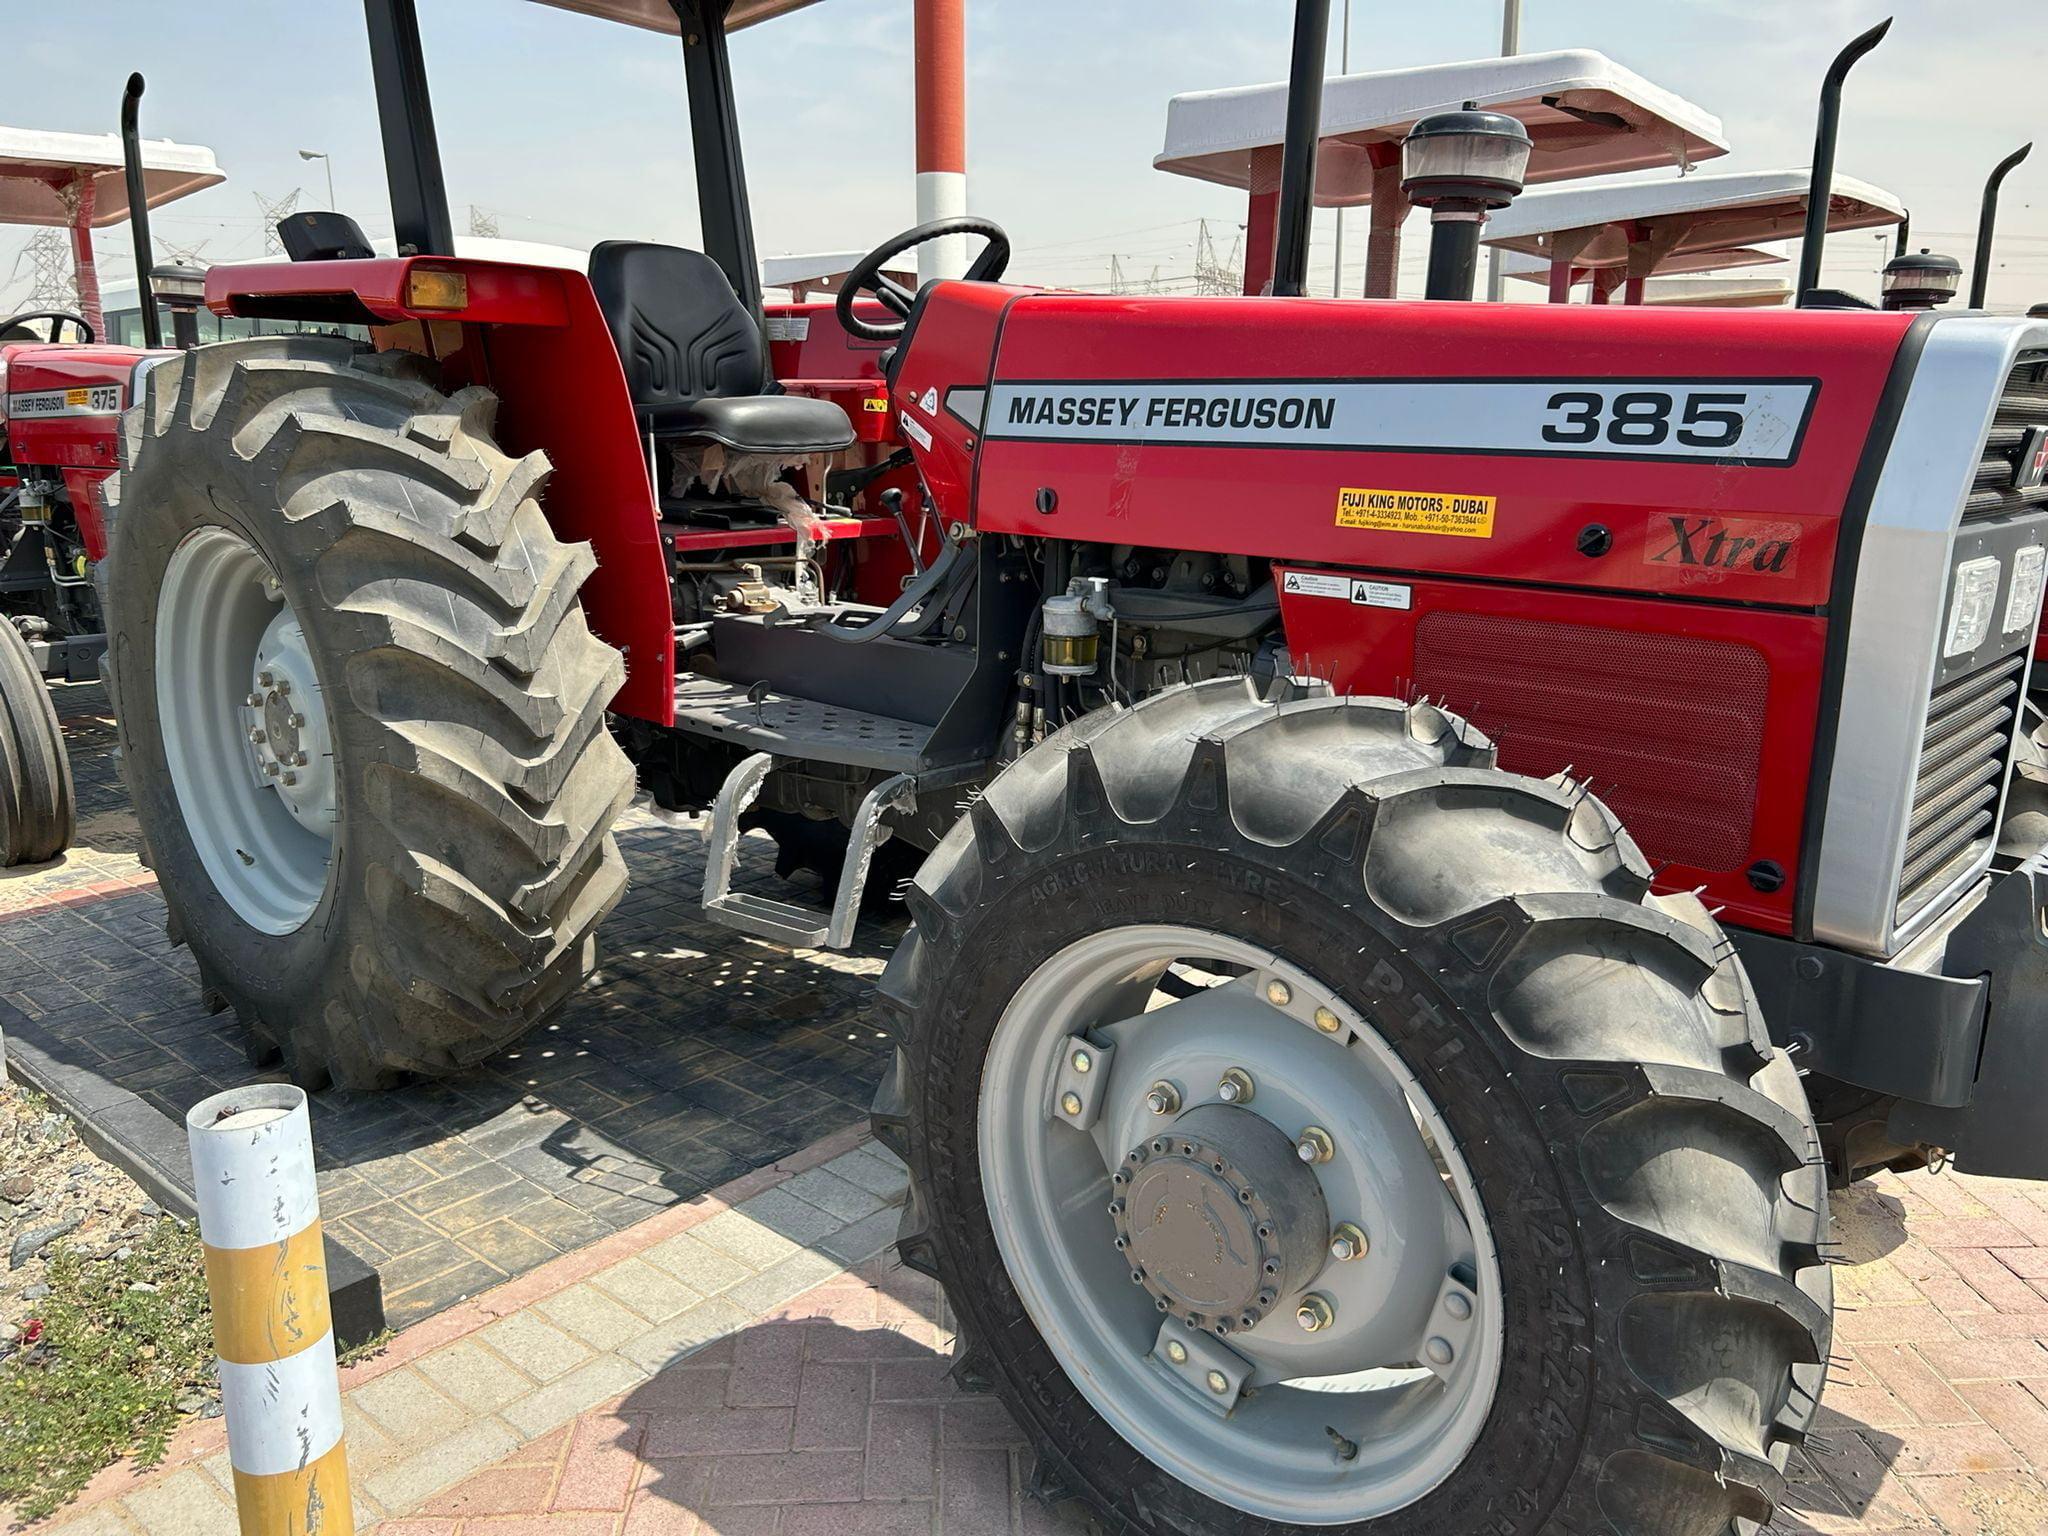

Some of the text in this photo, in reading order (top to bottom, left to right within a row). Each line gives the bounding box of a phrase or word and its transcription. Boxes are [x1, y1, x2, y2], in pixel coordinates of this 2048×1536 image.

[13, 398, 35, 413] MASSEY
[35, 396, 65, 412] FERGUSON
[92, 389, 117, 411] 375
[1008, 397, 1336, 430] MASSEY FERGUSON
[1541, 392, 1747, 448] 385
[1342, 493, 1366, 507] FUJI
[1368, 494, 1395, 509] KING
[1397, 496, 1443, 512] MOTORS
[1452, 499, 1488, 515] DUBAI
[1651, 516, 1794, 573] Xtra
[1368, 584, 1389, 592] CAUTION
[1215, 861, 1283, 897] TYRE
[1088, 892, 1216, 919] HEAVY DUTY
